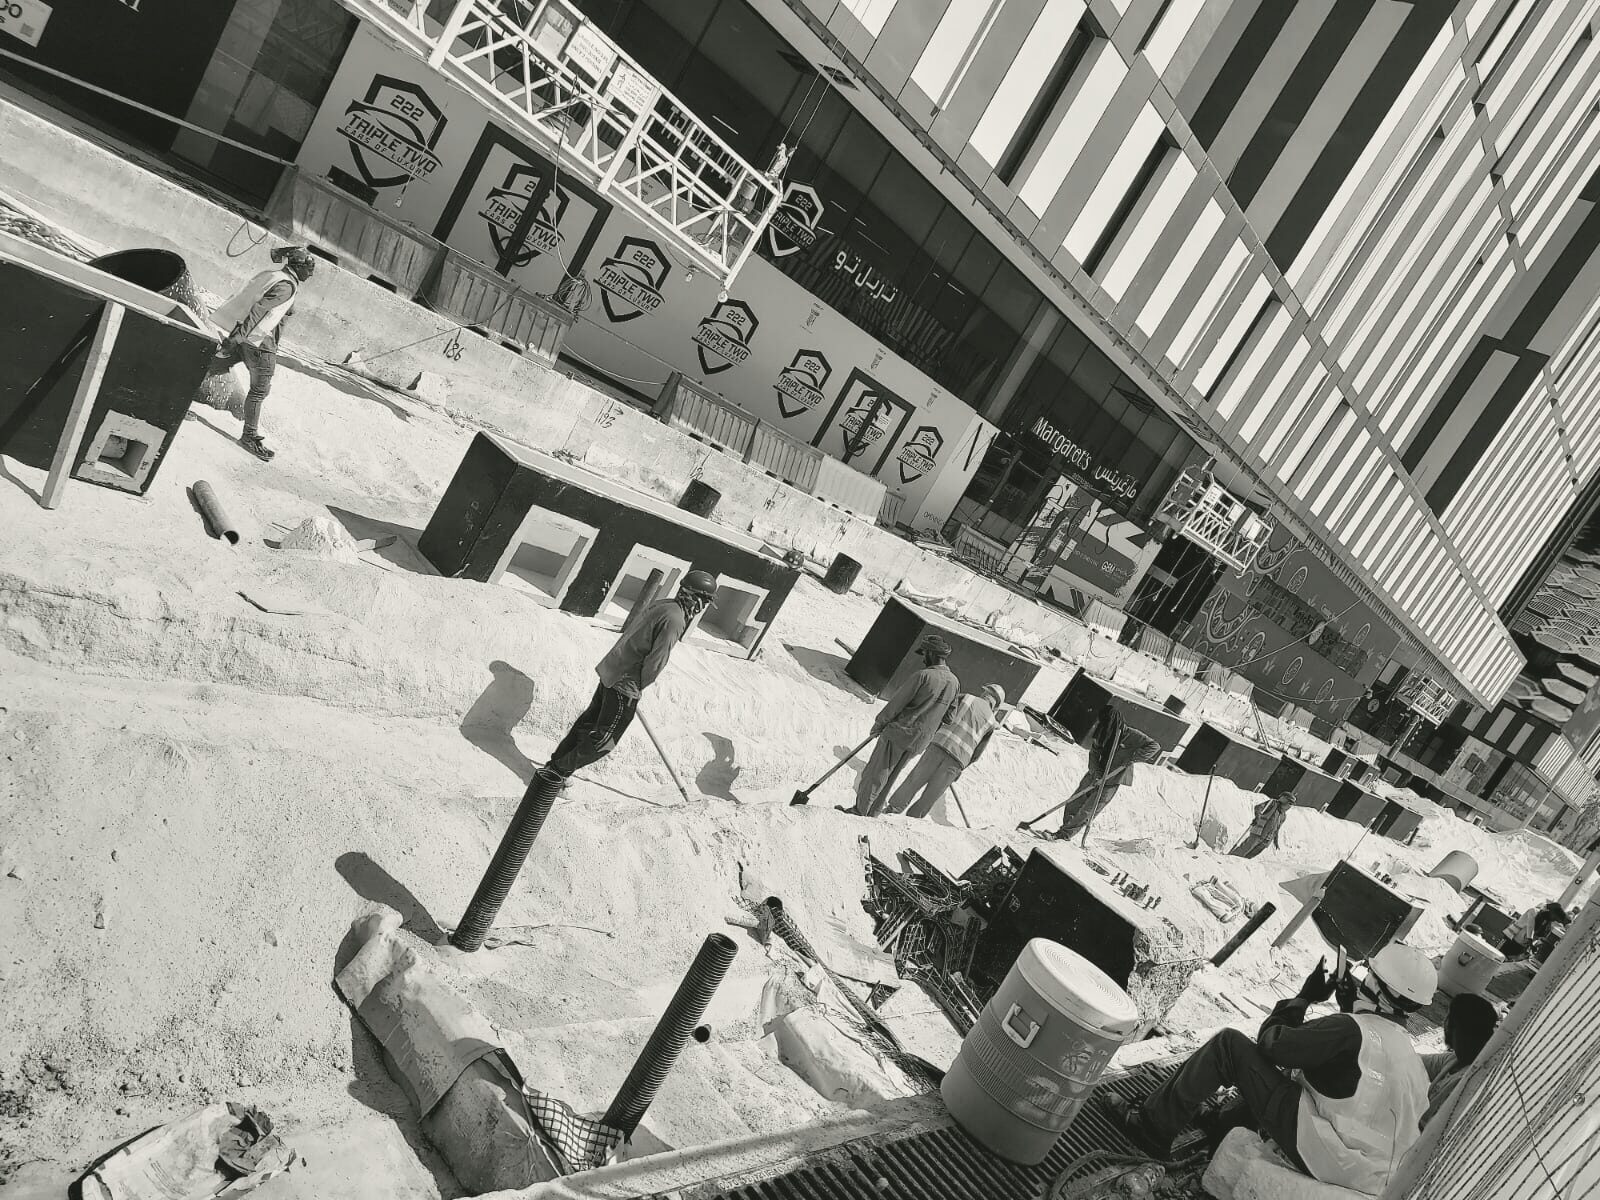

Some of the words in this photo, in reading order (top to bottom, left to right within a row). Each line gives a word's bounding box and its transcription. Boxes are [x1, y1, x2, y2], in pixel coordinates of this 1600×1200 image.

[390, 95, 425, 121] 222
[345, 126, 371, 143] CARS
[374, 144, 388, 153] OF
[391, 153, 428, 178] LUXURY
[348, 114, 402, 152] TRIPLE
[402, 146, 438, 173] TWO
[795, 194, 813, 211] 222
[485, 210, 506, 225] CARS
[526, 235, 553, 251] UXURY
[531, 225, 561, 247] TWO
[774, 211, 798, 231] RIPLE
[797, 228, 815, 246] TWO
[633, 250, 656, 269] 222
[601, 267, 638, 294] TRIPLE
[637, 289, 661, 308] TWO
[726, 310, 746, 326] 222
[443, 338, 465, 361] 186
[699, 326, 730, 349] TRIPLE
[729, 344, 749, 360] TWO
[804, 359, 821, 374] 222
[780, 375, 806, 395] TRIPLE
[804, 390, 822, 405] TWO
[1032, 416, 1092, 470] Margaret's
